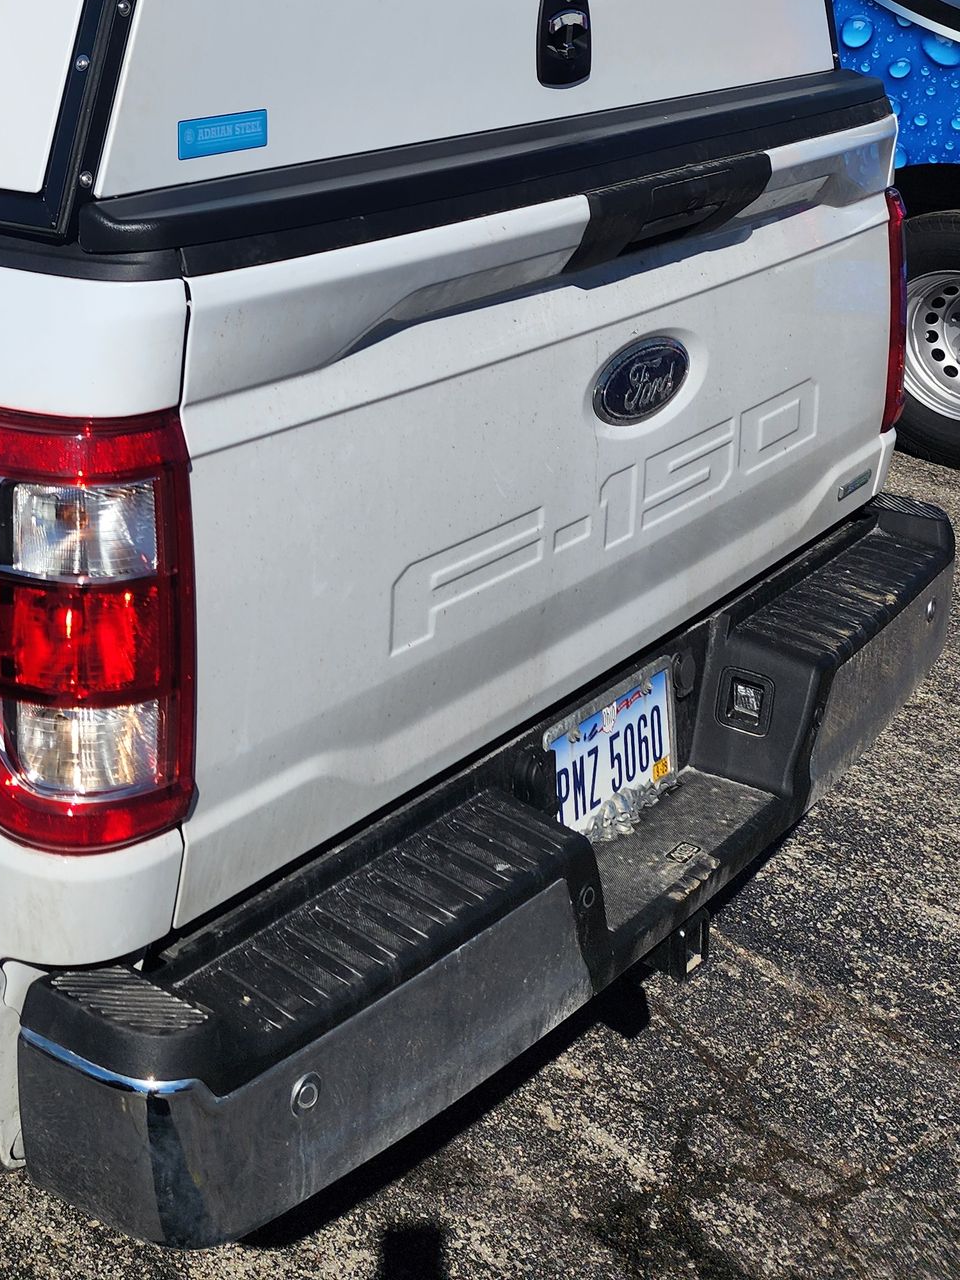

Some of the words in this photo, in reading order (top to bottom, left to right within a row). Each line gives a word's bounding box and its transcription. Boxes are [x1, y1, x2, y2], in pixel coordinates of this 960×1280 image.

[197, 124, 233, 141] ADRIAN
[234, 121, 263, 135] STEEL
[624, 357, 676, 411] Ford
[389, 377, 819, 658] F-150
[556, 745, 602, 825] PMZ
[609, 704, 664, 794] 5060
